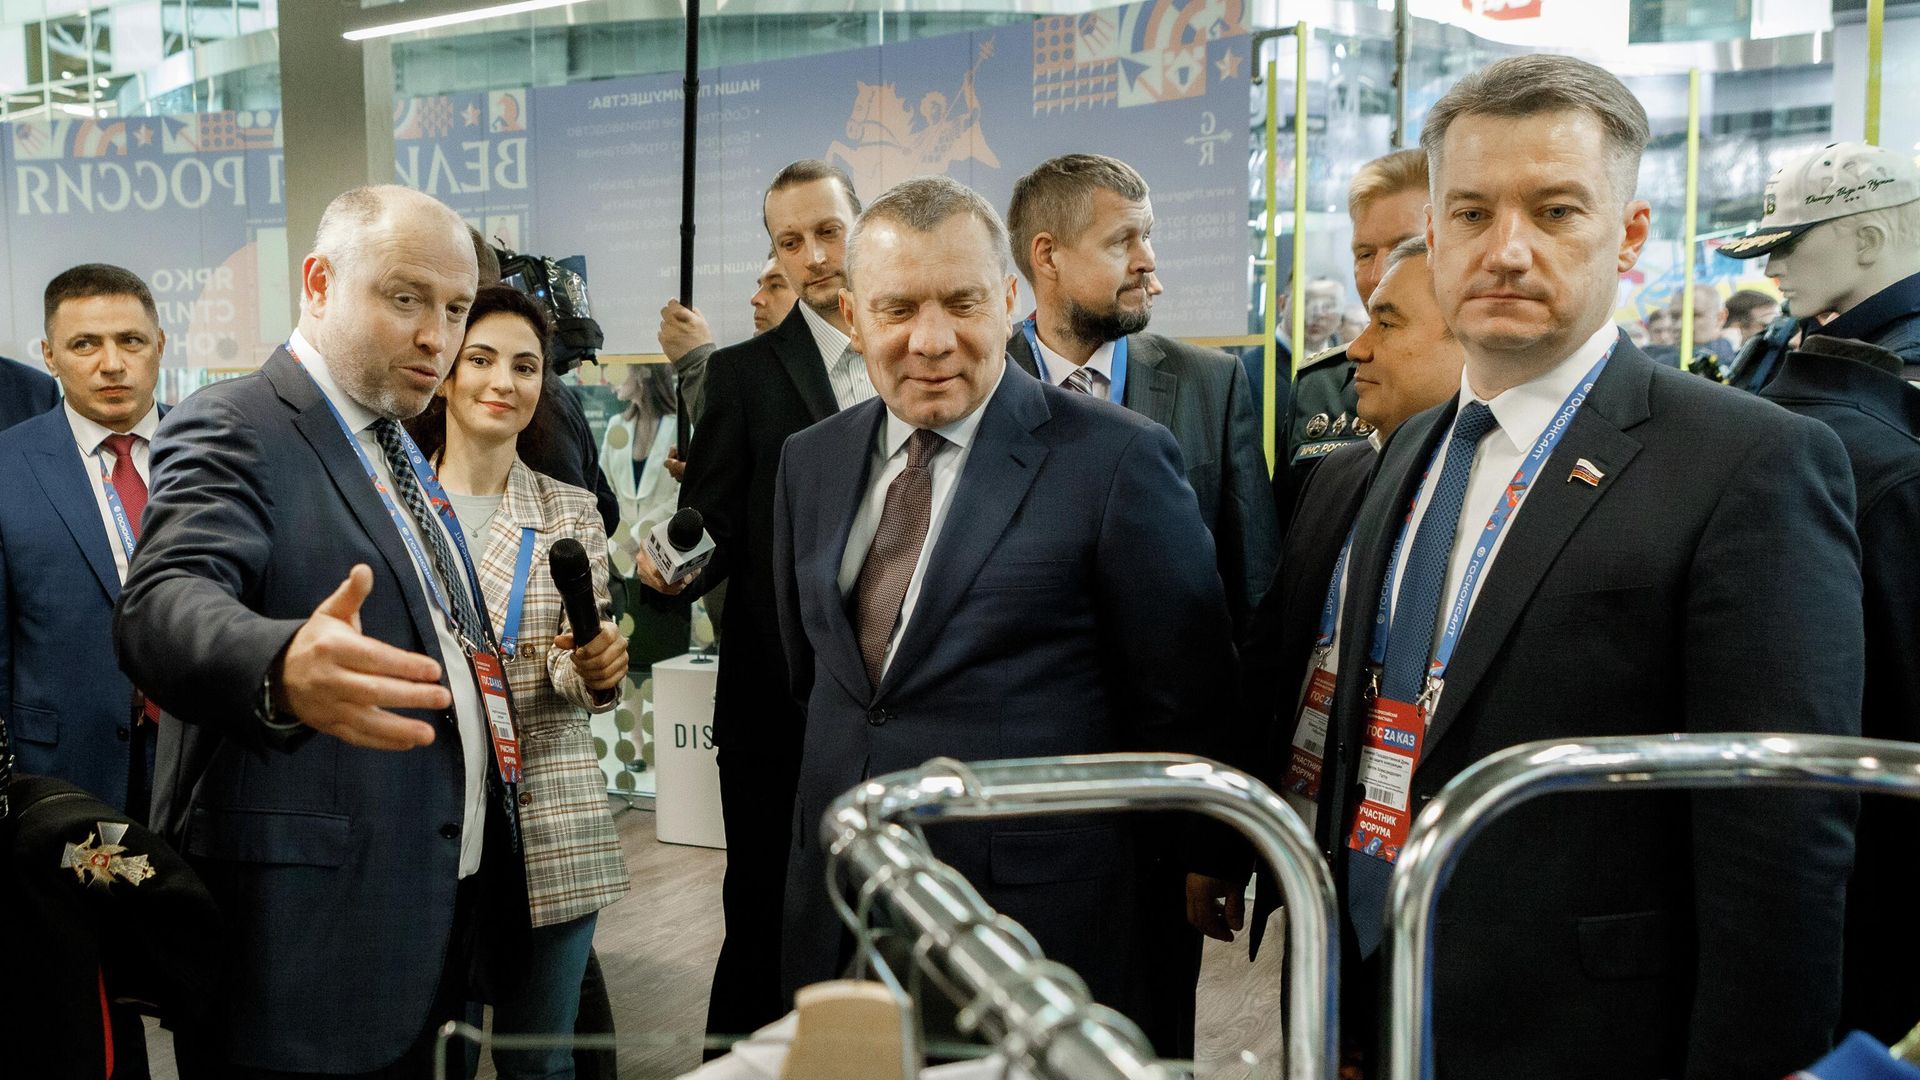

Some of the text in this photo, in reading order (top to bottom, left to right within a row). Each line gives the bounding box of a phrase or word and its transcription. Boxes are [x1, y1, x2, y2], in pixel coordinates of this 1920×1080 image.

[1532, 391, 1587, 462] ГОСКОНСАЛТ
[116, 512, 136, 555] ГОСКОНСАЛ
[1448, 559, 1480, 639] ГОСКОНСАЛТ
[675, 723, 714, 750] DIS
[1359, 805, 1397, 826] УЧАСТНИК
[1359, 820, 1391, 839] ФОРУМА
